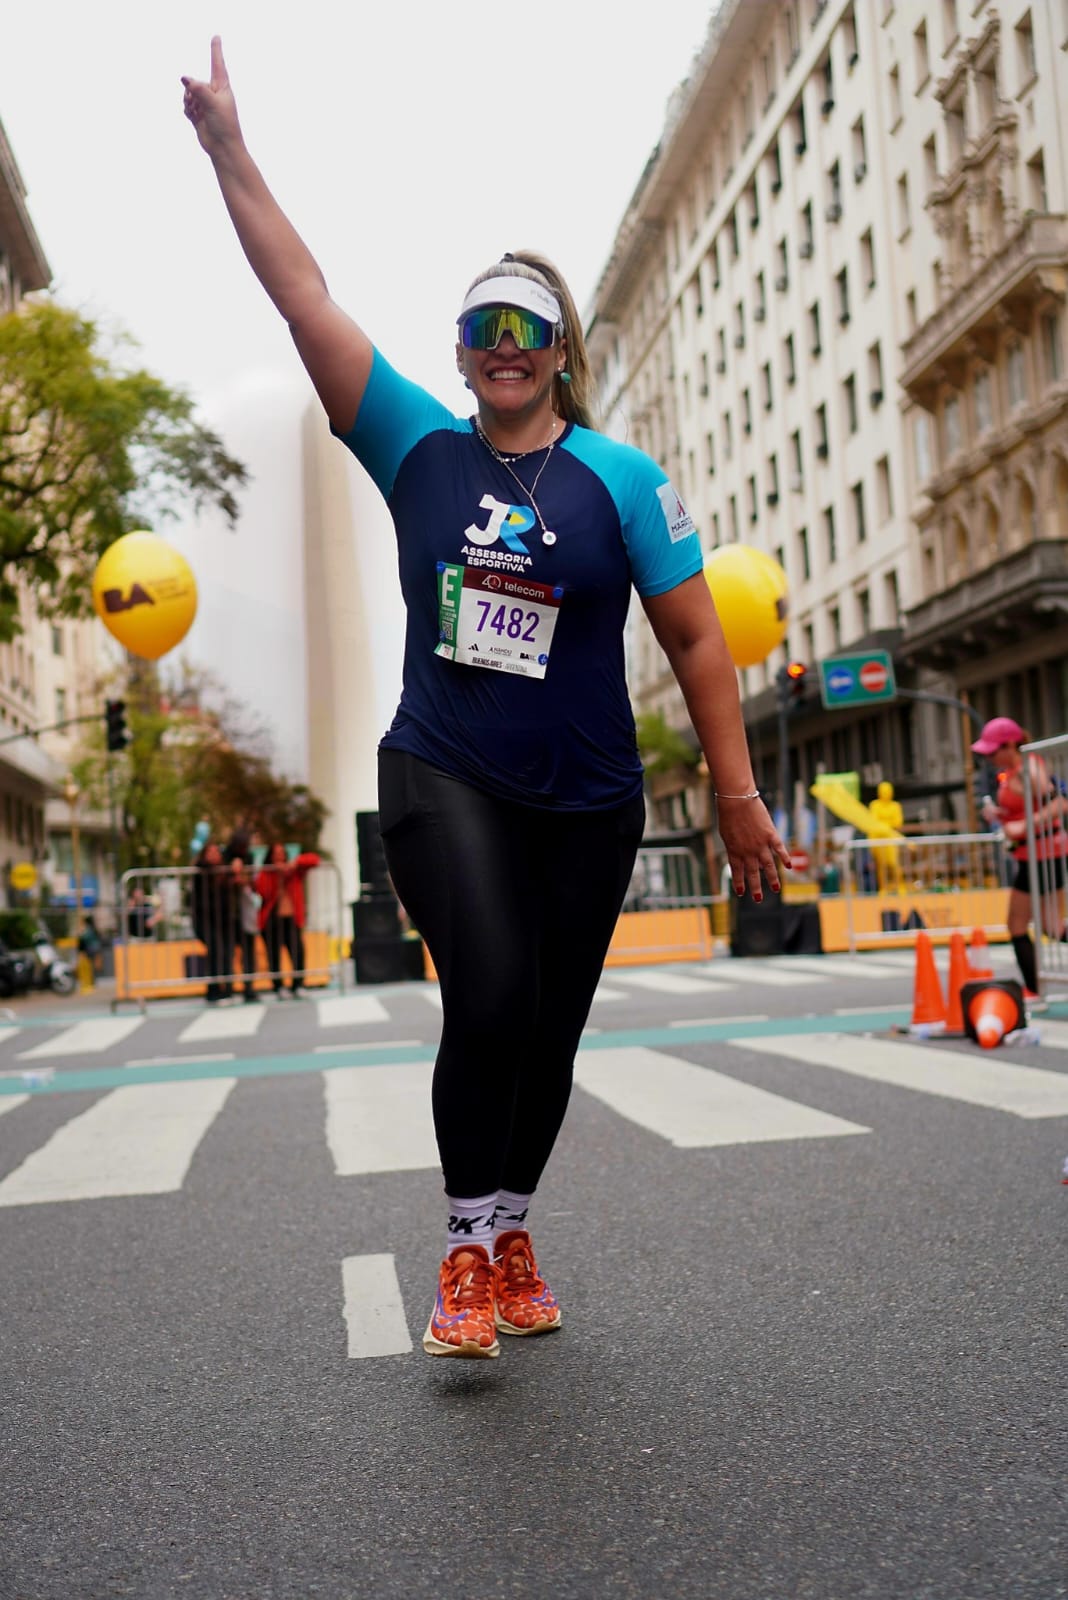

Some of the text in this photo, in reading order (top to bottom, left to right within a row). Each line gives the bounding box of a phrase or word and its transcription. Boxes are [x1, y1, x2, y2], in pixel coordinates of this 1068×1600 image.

[461, 546, 532, 566] ASSESSORIA
[467, 556, 525, 573] ESPORTIVA
[442, 568, 458, 607] E
[504, 581, 545, 599] telecom
[476, 600, 540, 643] 7482
